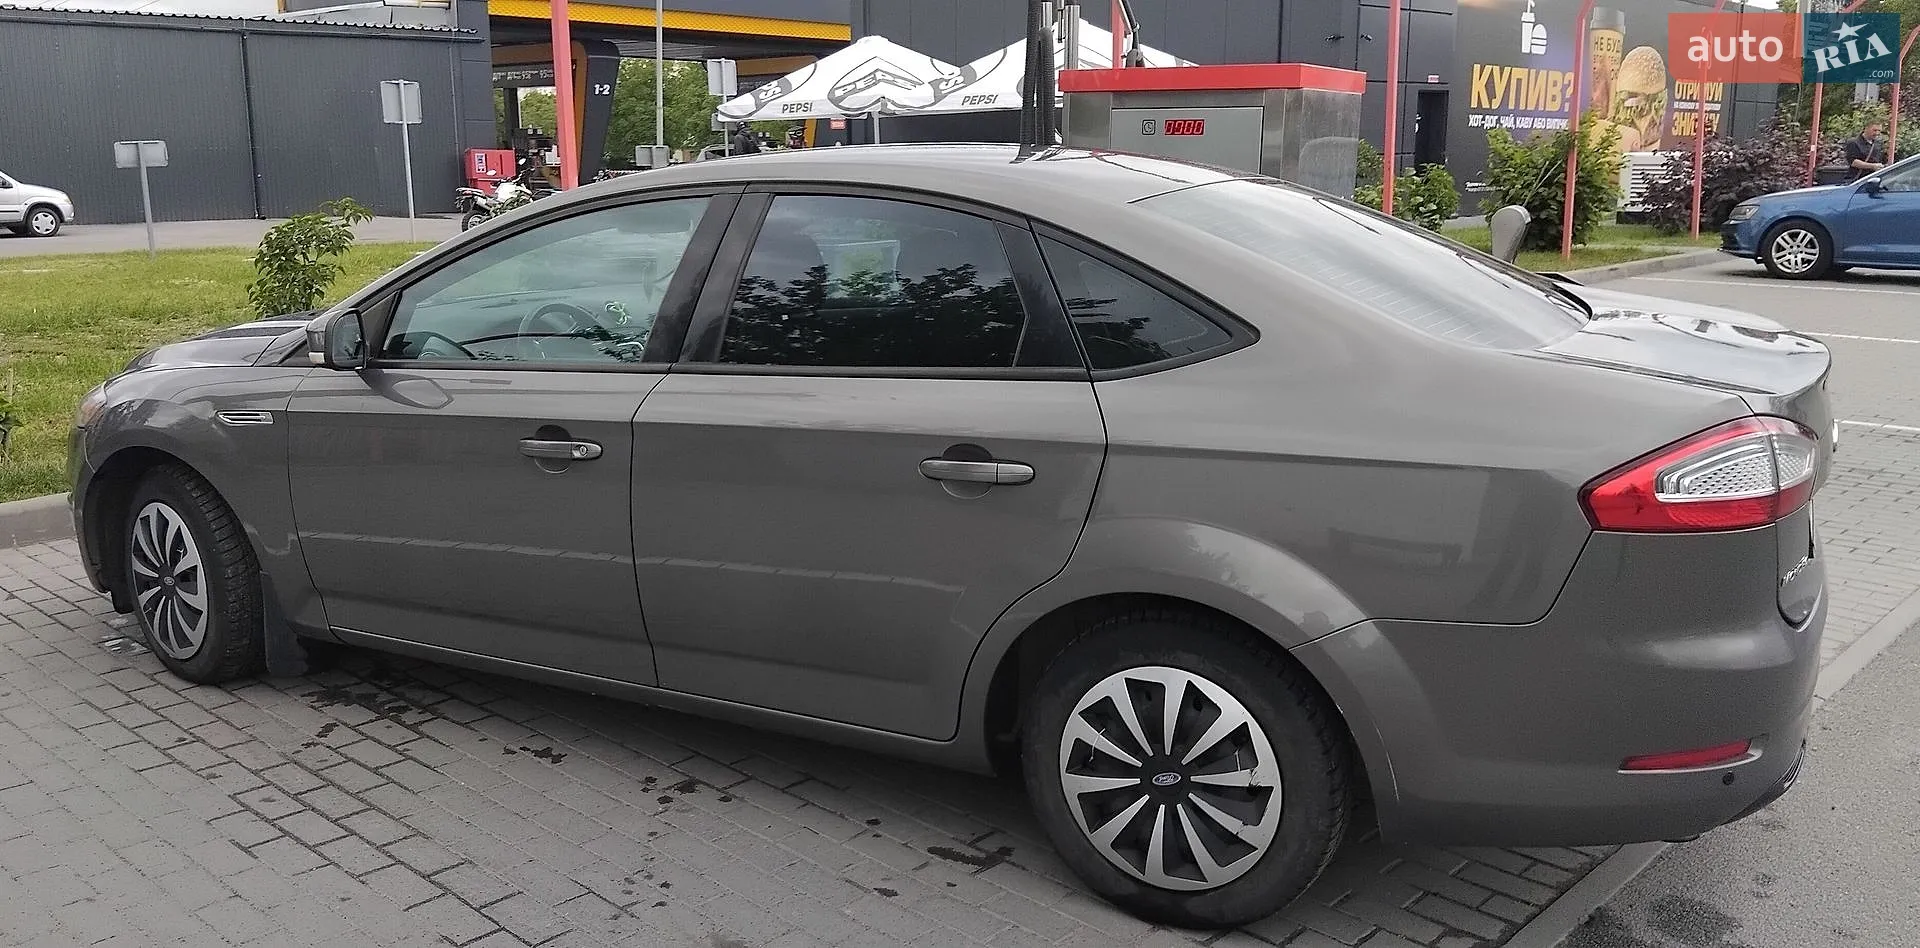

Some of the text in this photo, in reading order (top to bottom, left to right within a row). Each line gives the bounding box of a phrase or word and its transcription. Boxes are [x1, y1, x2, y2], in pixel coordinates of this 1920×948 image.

[593, 83, 611, 95] 1-2
[1470, 63, 1575, 112] КУПИВ?
[961, 94, 999, 107] PEPSI
[781, 102, 813, 114] PEPSI
[1468, 113, 1500, 130] ХОТ-ДОГ,
